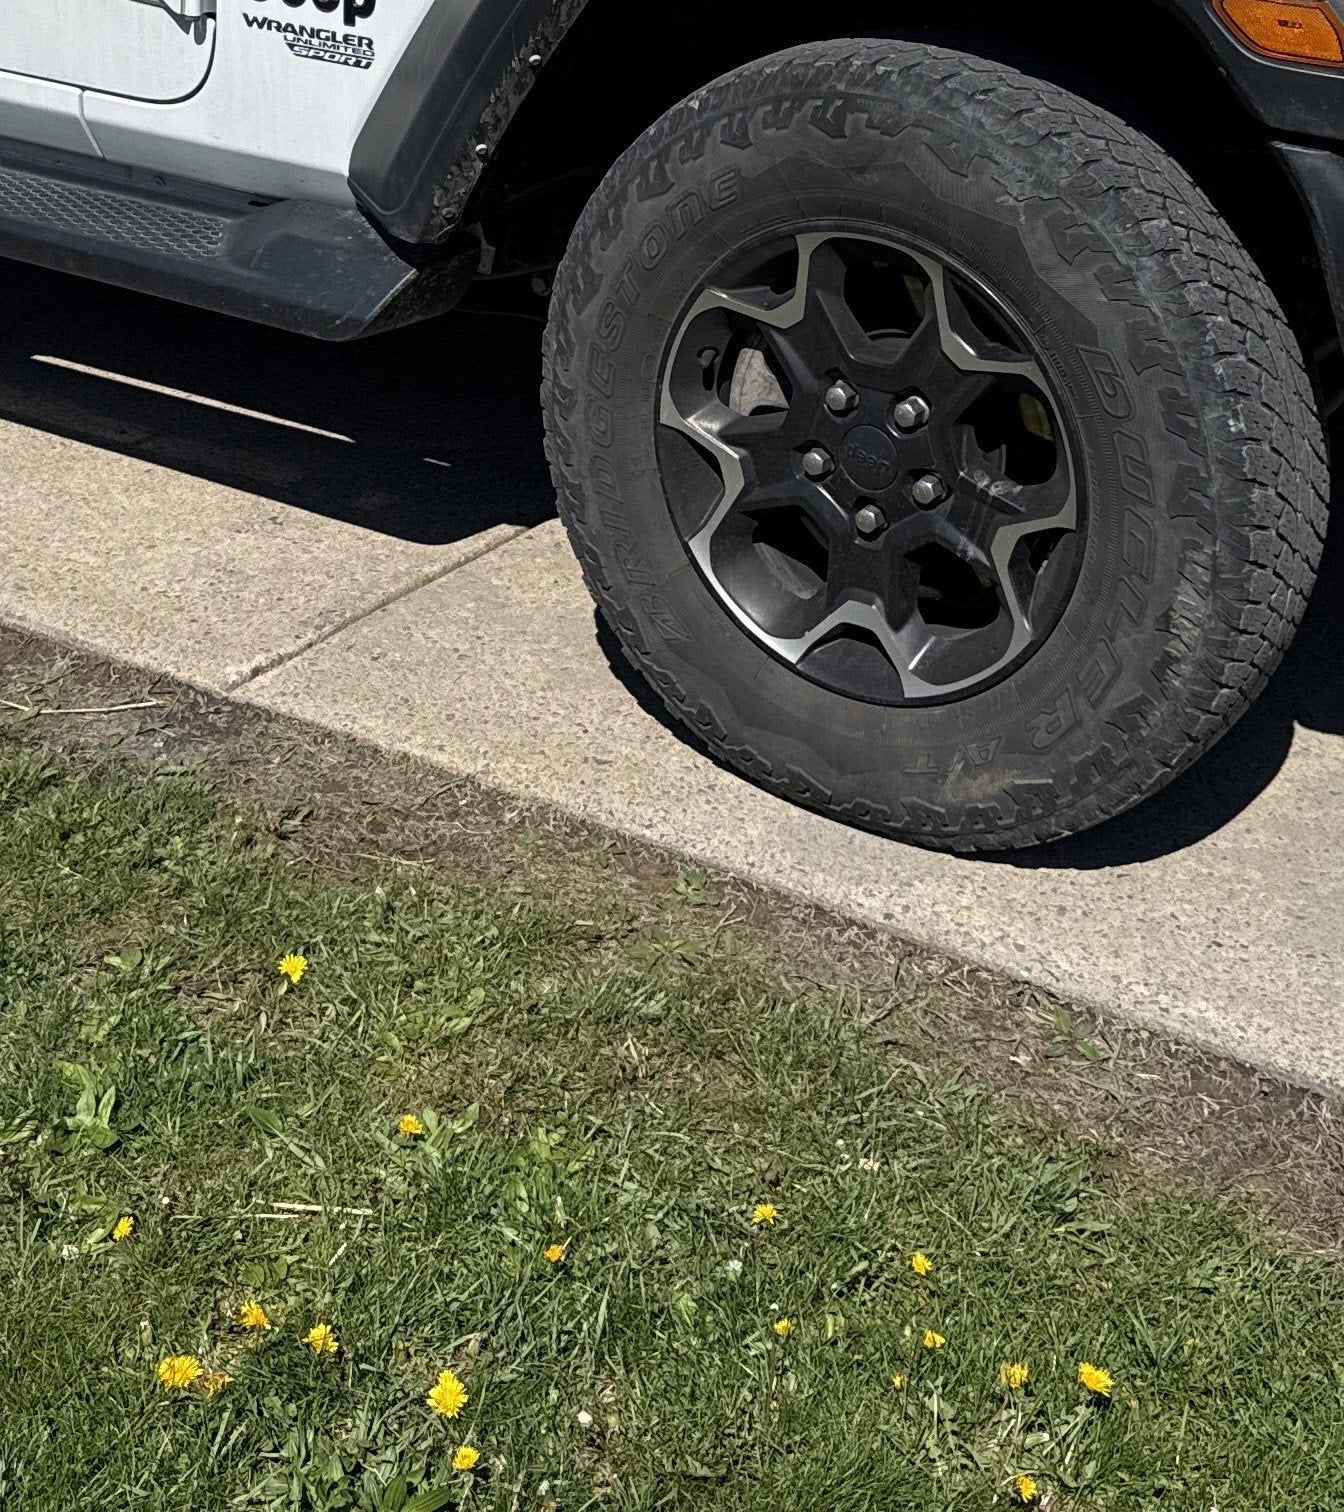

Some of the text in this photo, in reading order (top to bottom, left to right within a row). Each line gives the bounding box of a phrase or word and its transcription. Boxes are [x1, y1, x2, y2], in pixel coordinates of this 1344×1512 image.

[242, 13, 374, 50] WRANGLER
[283, 35, 375, 57] UNLIMITED
[293, 47, 373, 68] SPORT
[584, 168, 740, 644] BRIDGESTONE
[847, 443, 891, 477] Jeep
[1027, 345, 1158, 752] DUELER
